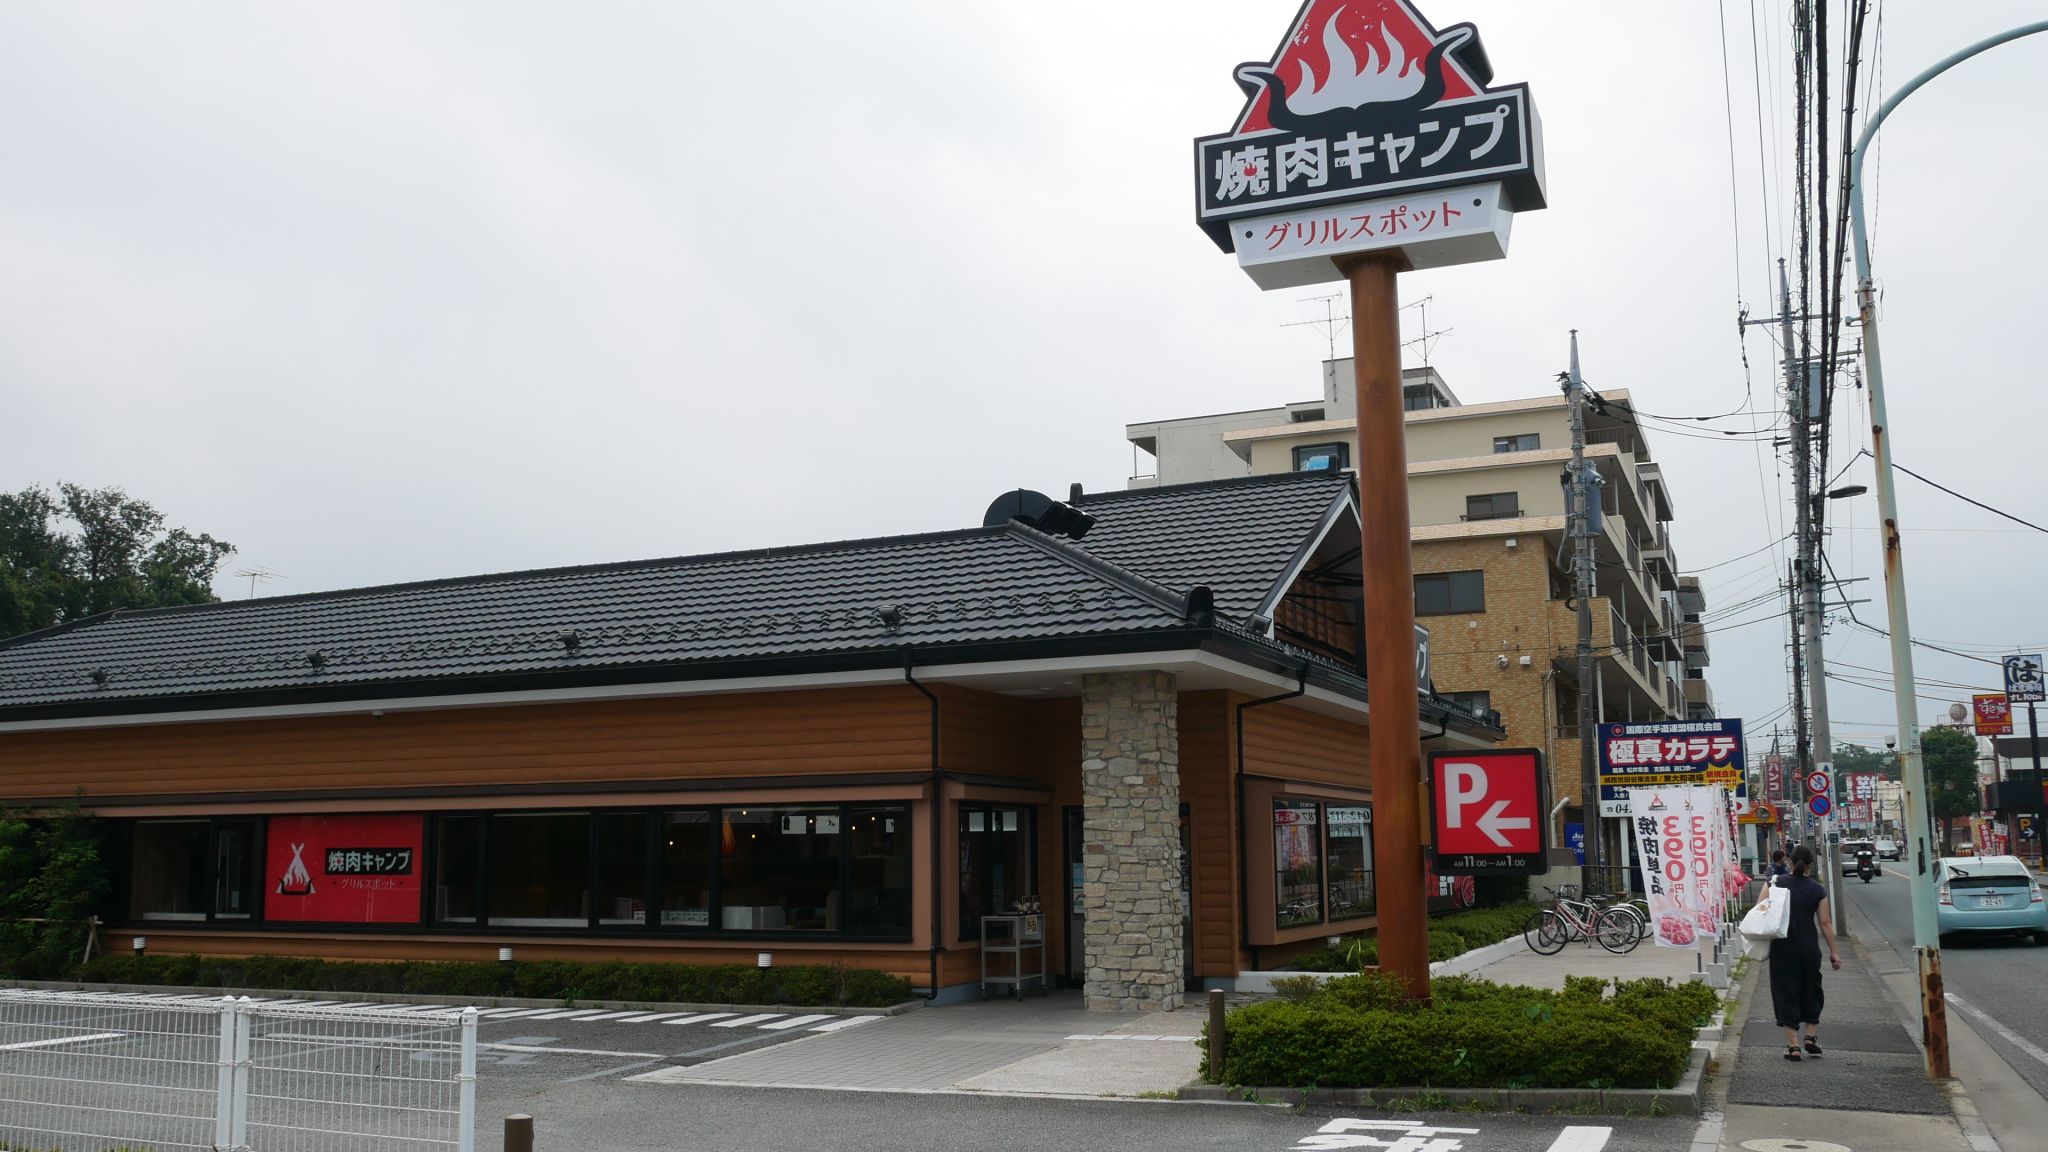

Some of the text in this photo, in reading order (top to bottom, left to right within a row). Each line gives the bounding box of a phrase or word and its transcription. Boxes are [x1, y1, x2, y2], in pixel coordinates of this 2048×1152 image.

[1215, 104, 1510, 200] 焼肉キャンプ
[1264, 202, 1462, 250] グリルスポット
[1609, 737, 1735, 764] 極真カラテ
[1444, 763, 1488, 828] P
[1616, 803, 1632, 814] 04
[2020, 818, 2030, 831] P
[328, 850, 411, 872] 焼肉キャンプ
[341, 877, 396, 890] グリルスポット
